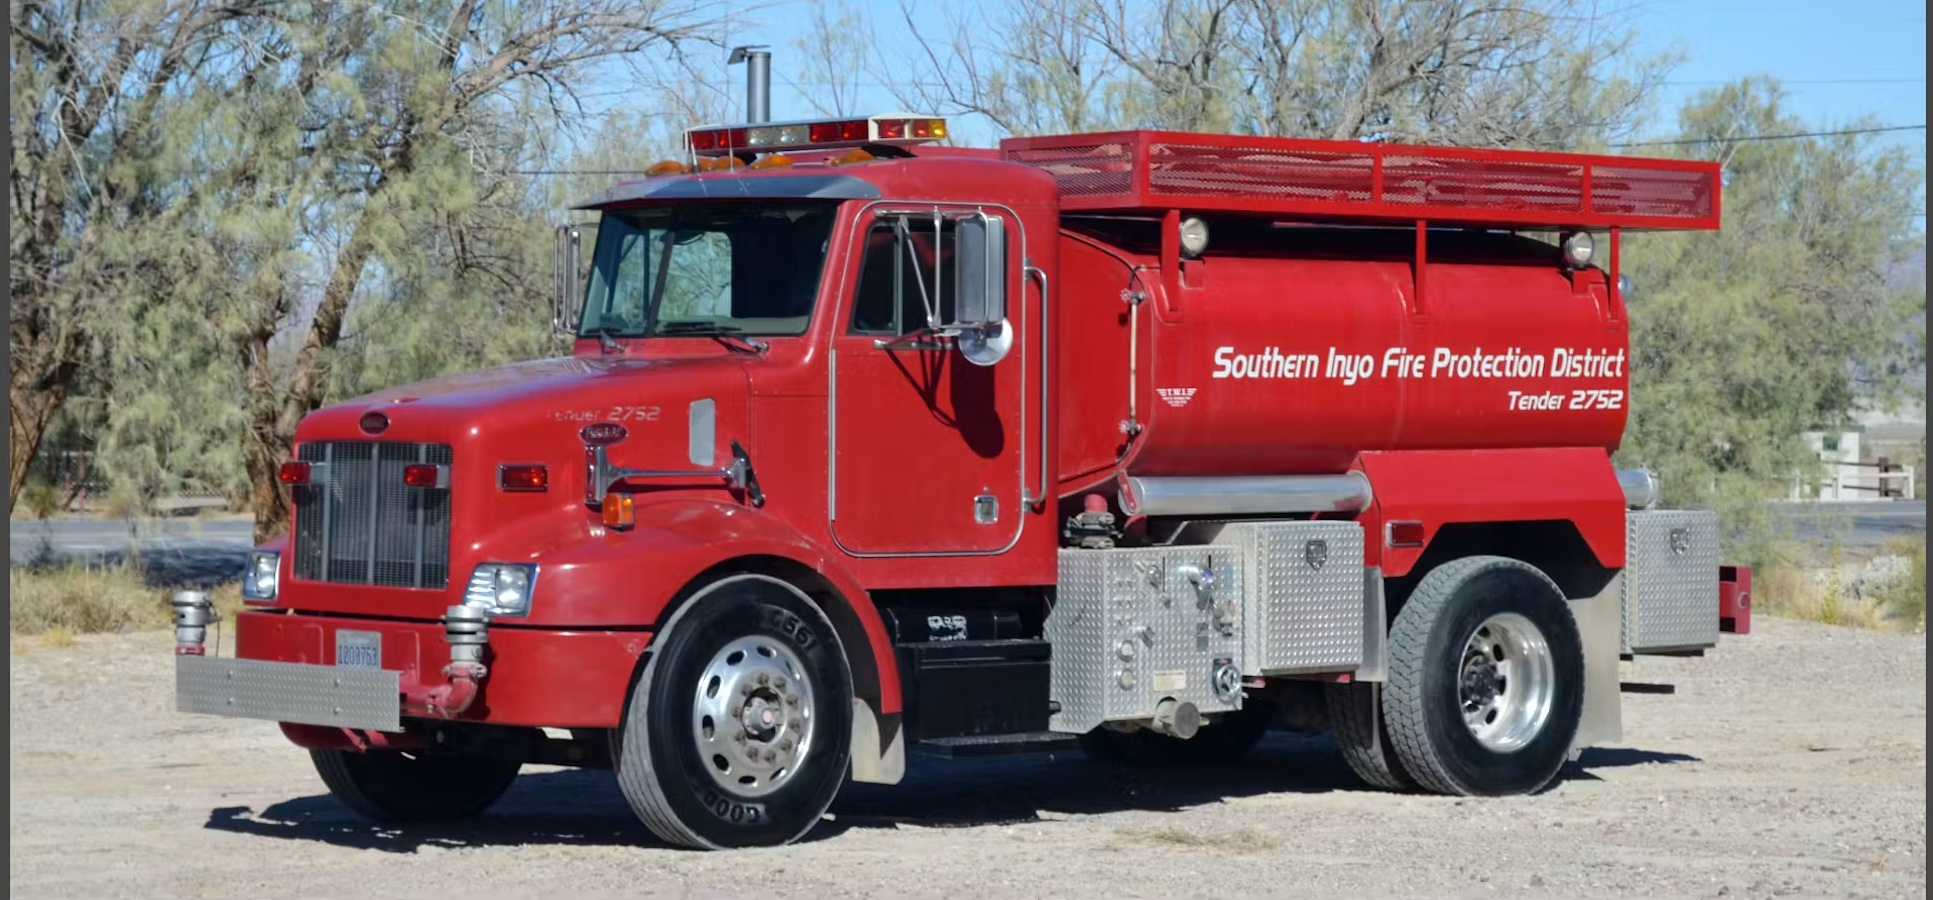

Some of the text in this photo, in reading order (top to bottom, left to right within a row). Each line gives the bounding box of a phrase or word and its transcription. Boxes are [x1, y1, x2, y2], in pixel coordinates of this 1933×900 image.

[1212, 346, 1625, 386] Southern Inyo Fire Protection District
[1508, 389, 1624, 411] Tender 2752
[607, 405, 661, 422] 2752
